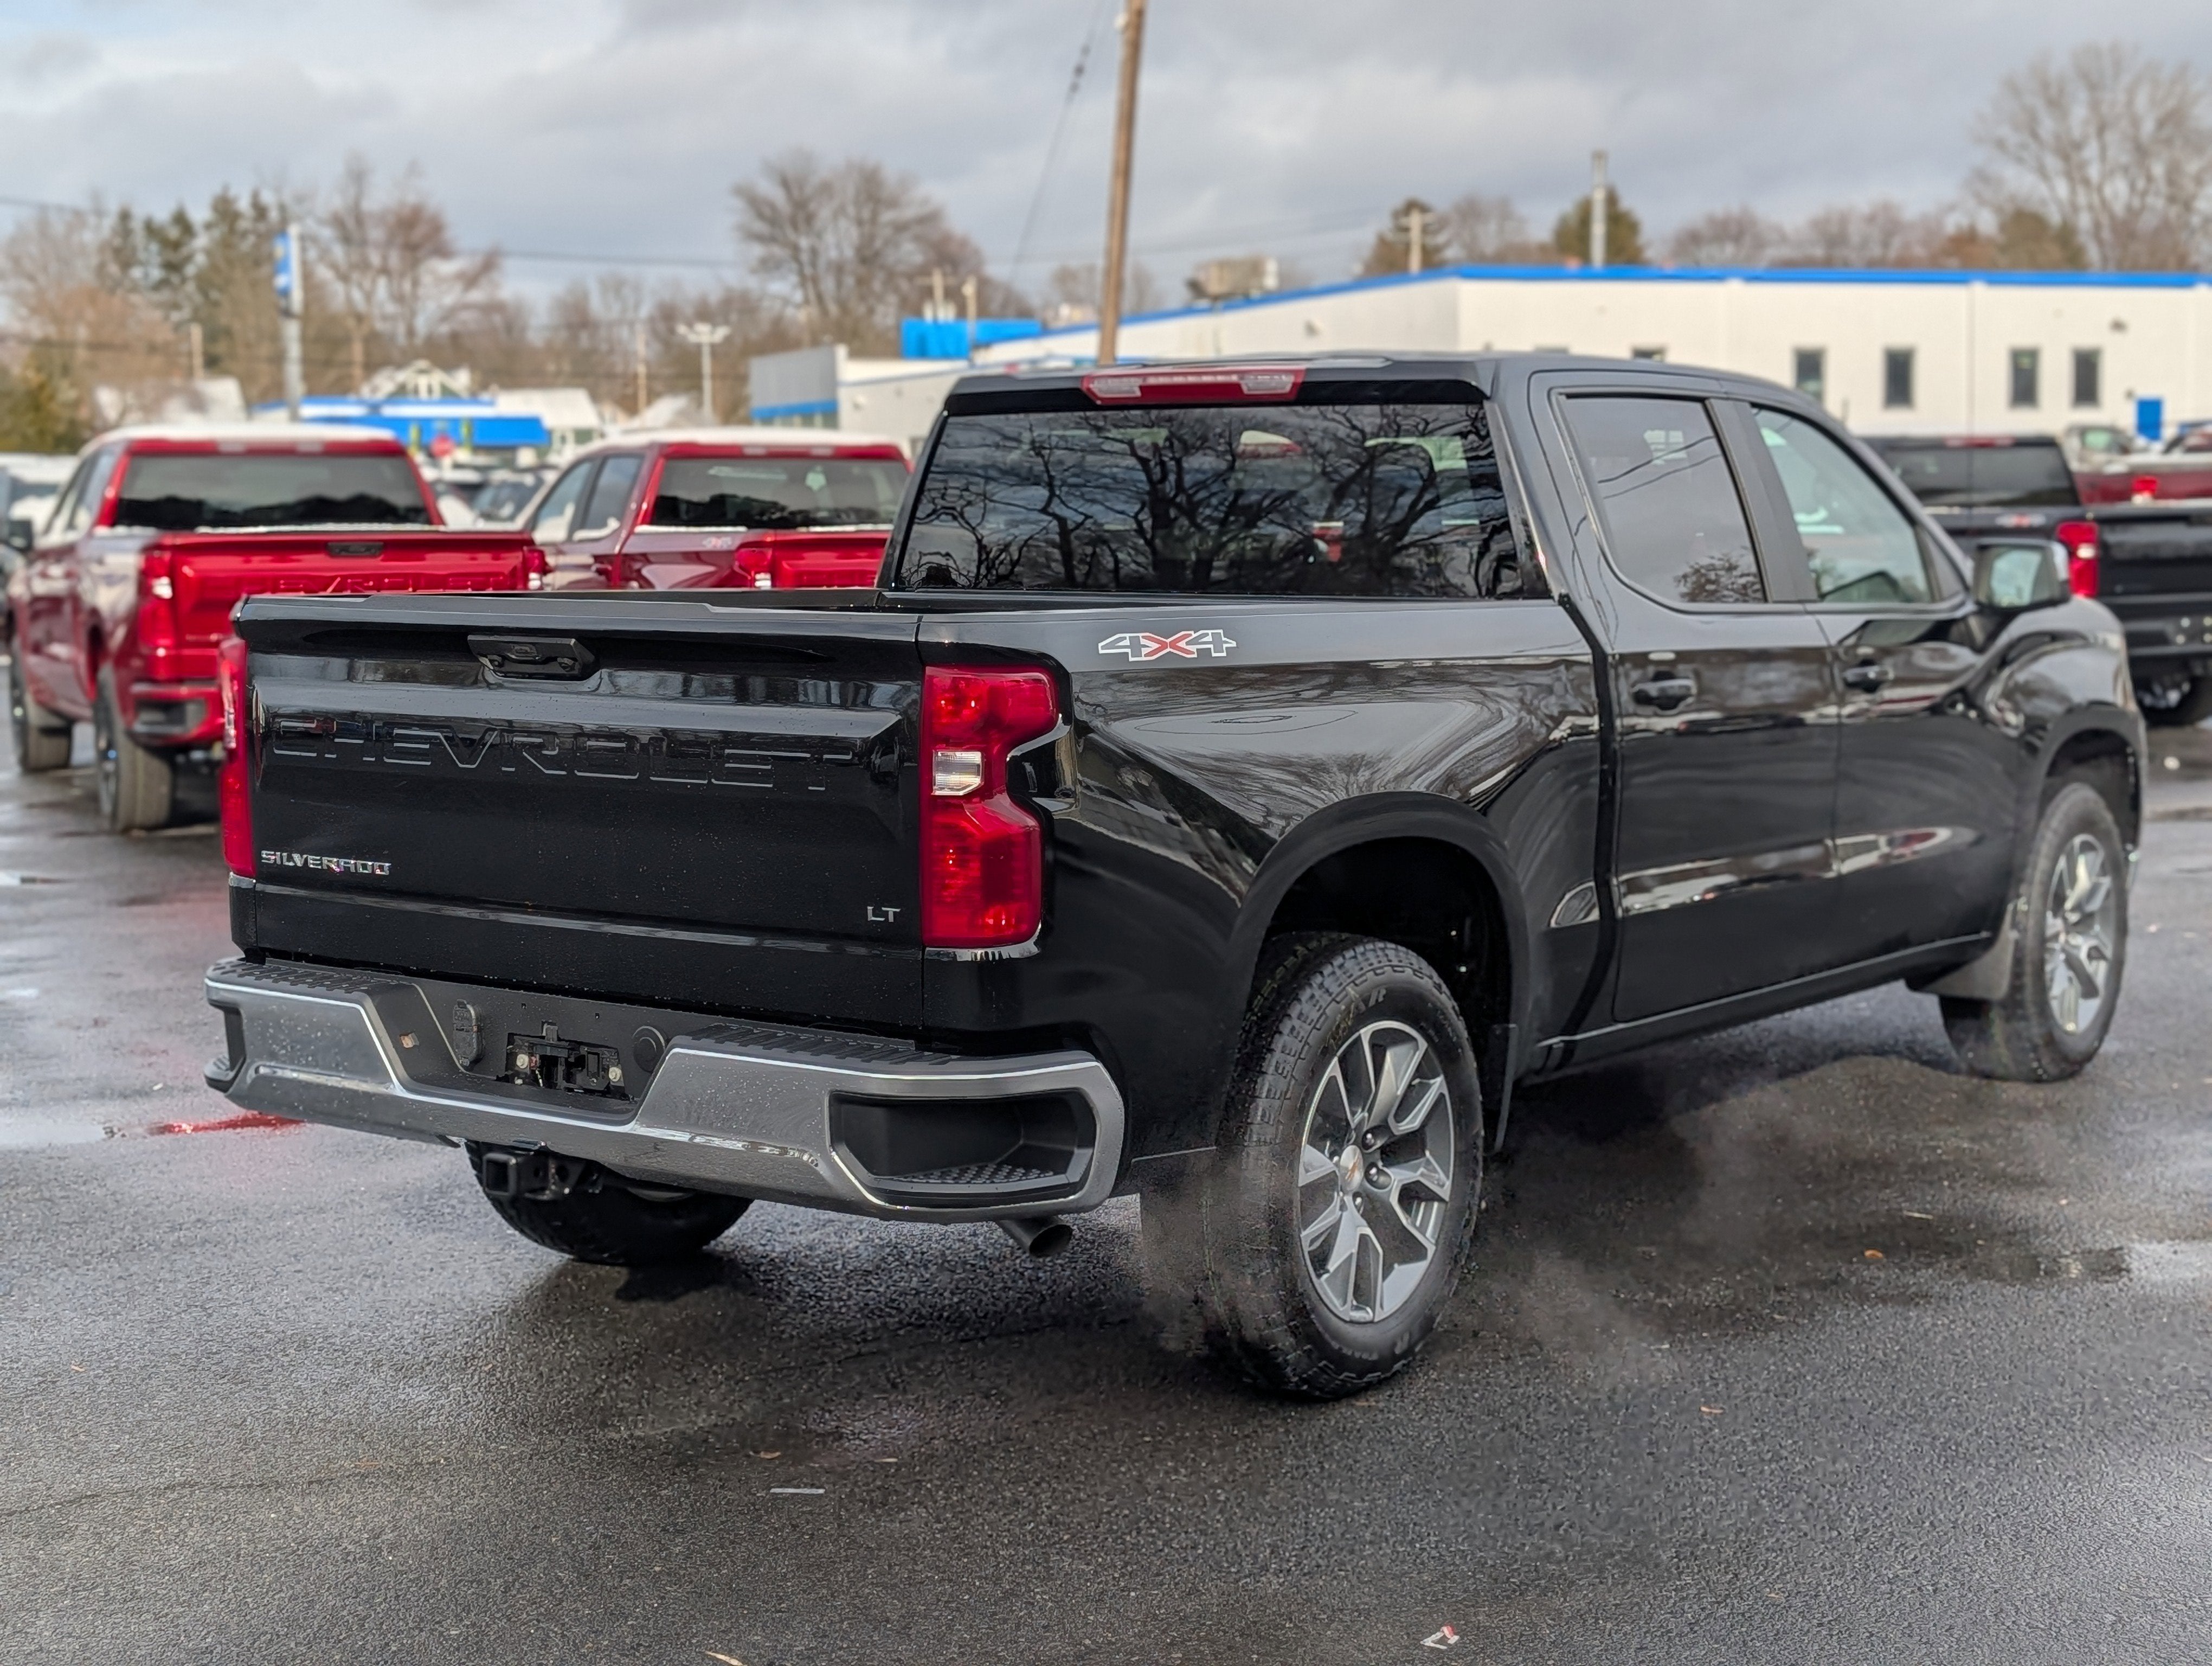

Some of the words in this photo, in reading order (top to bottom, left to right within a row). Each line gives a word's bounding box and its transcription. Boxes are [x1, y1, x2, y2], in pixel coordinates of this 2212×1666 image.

[272, 717, 854, 791] CHEVROLET
[261, 850, 391, 875] SILVERADO
[867, 906, 901, 922] LT
